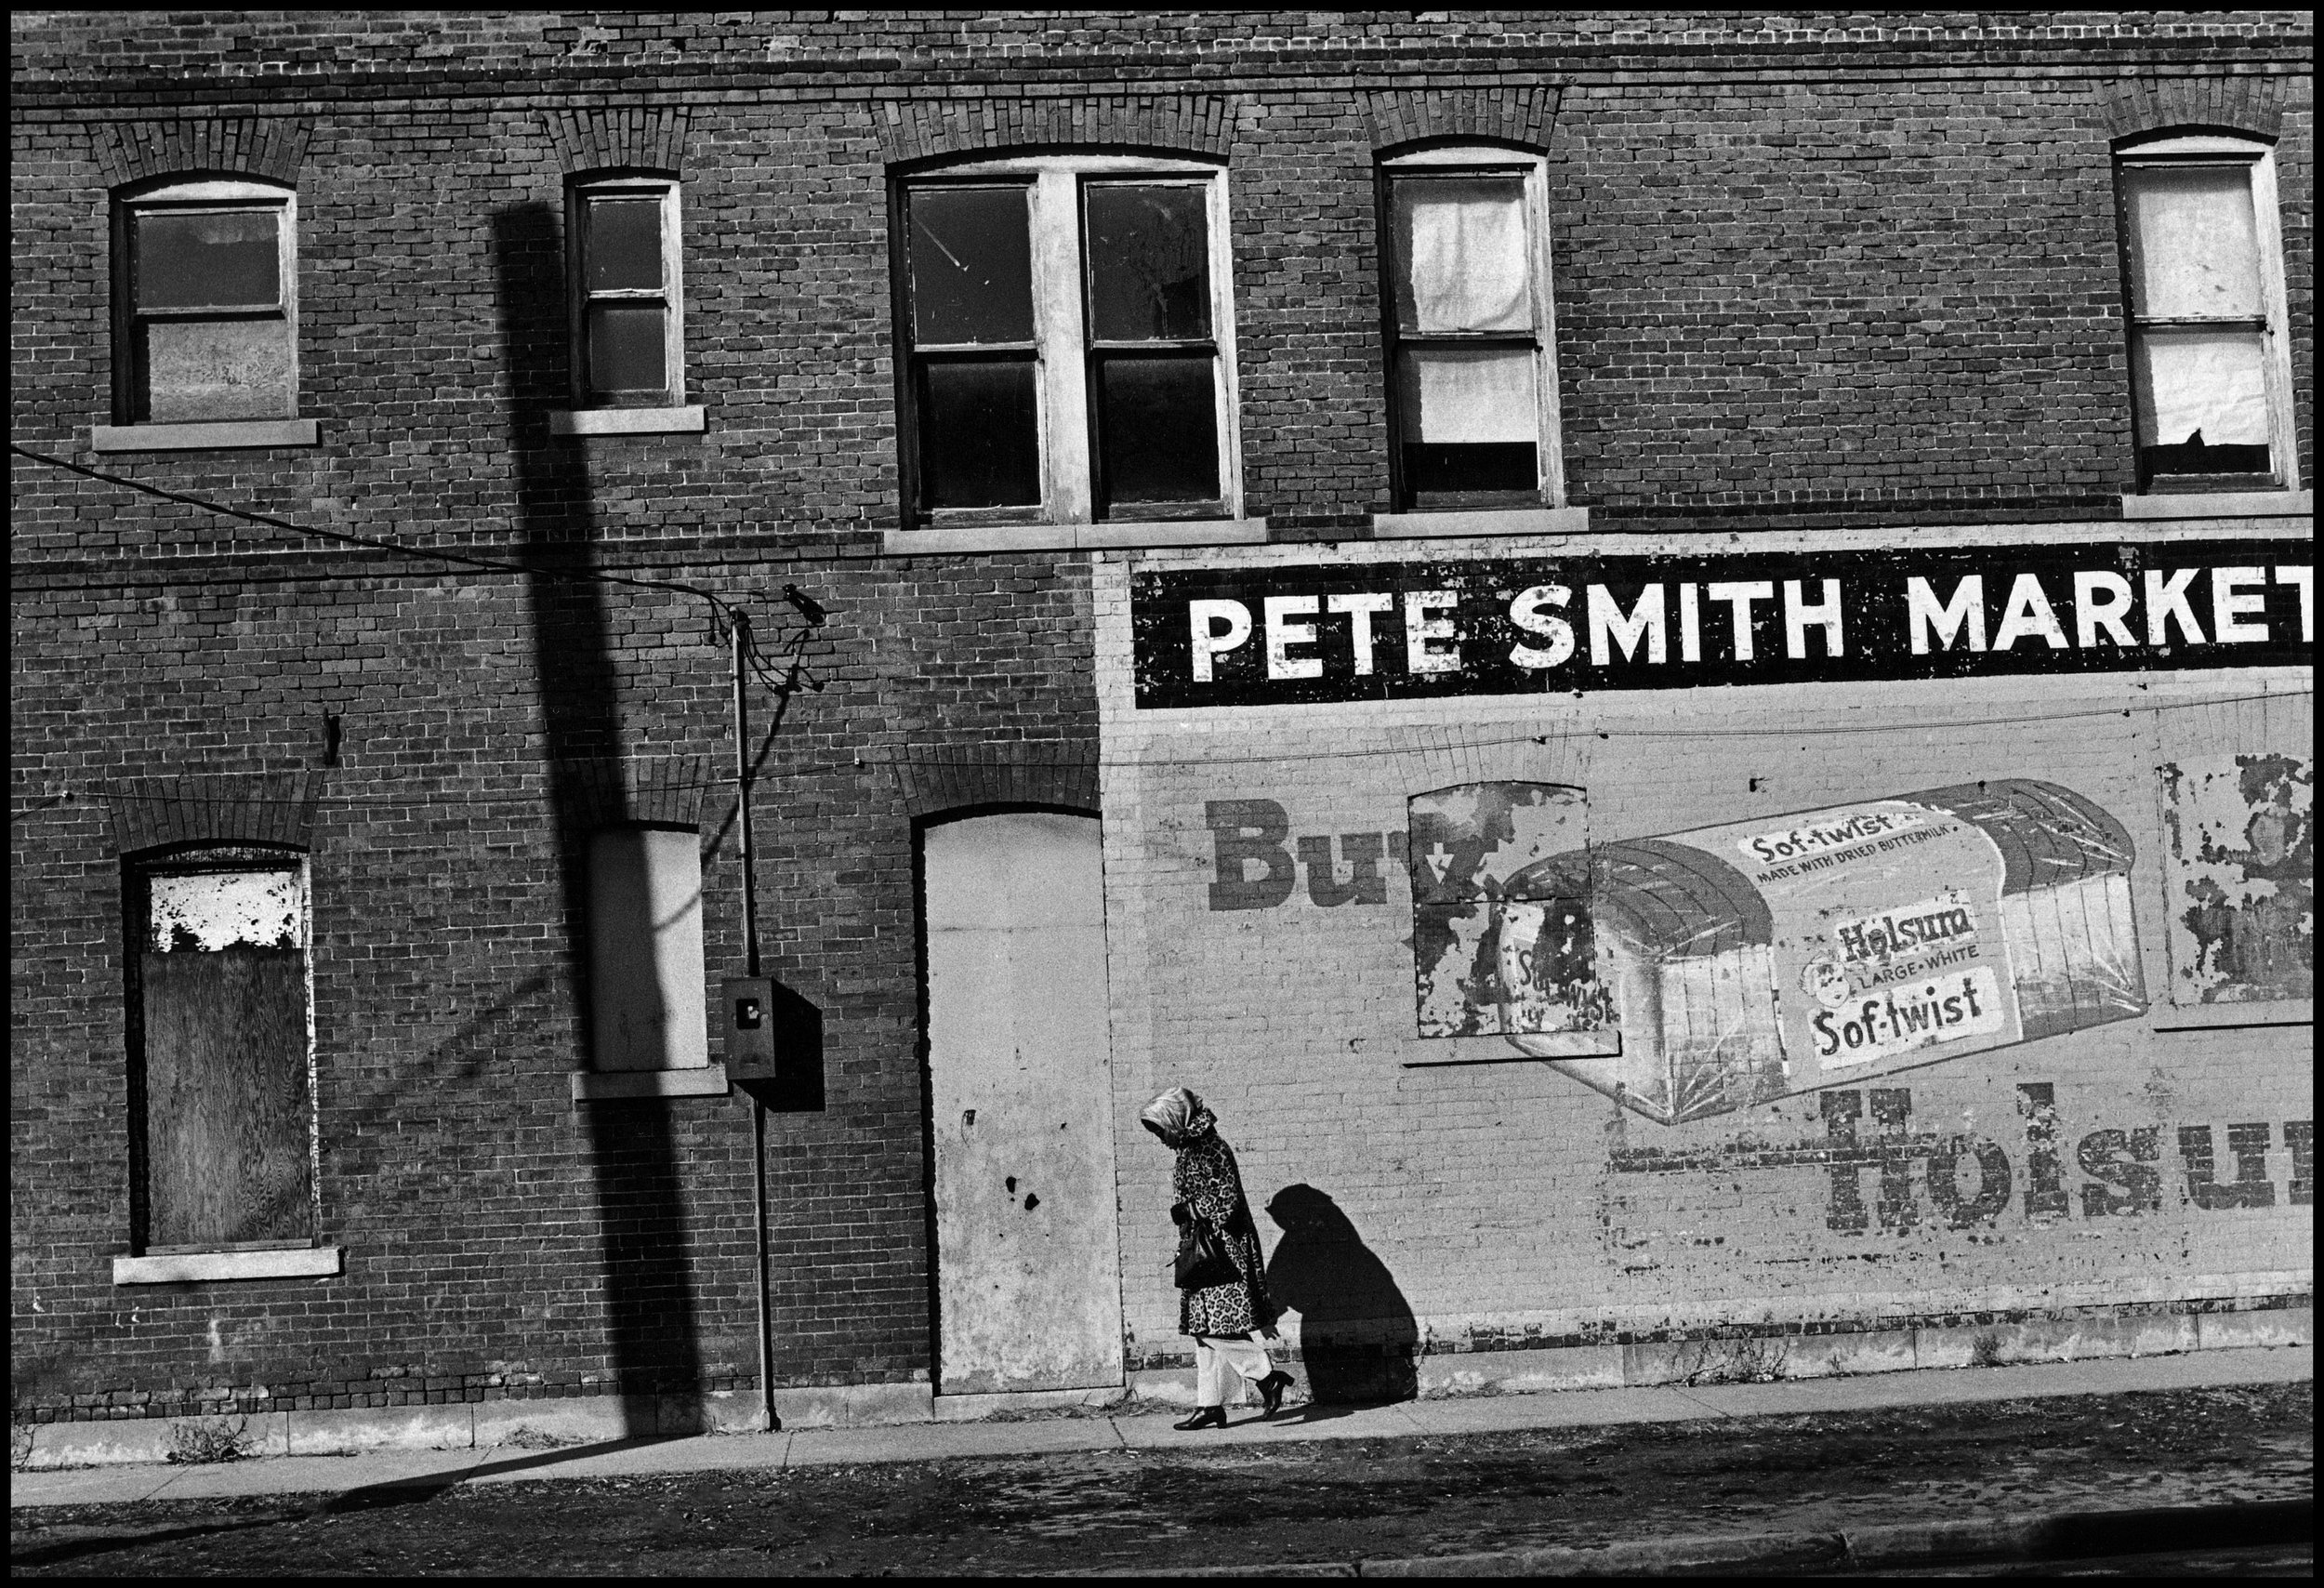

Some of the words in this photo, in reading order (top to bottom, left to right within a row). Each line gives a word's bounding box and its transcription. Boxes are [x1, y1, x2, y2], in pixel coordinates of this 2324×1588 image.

[1189, 589, 1460, 682] PETE
[1508, 577, 1843, 669] SMITH
[1756, 865, 1800, 884] MADE
[1797, 854, 1834, 874] WITH
[1834, 843, 1877, 864] DRIED
[1877, 824, 1950, 853] BUTTERMILK
[1839, 906, 1974, 963] Holsum
